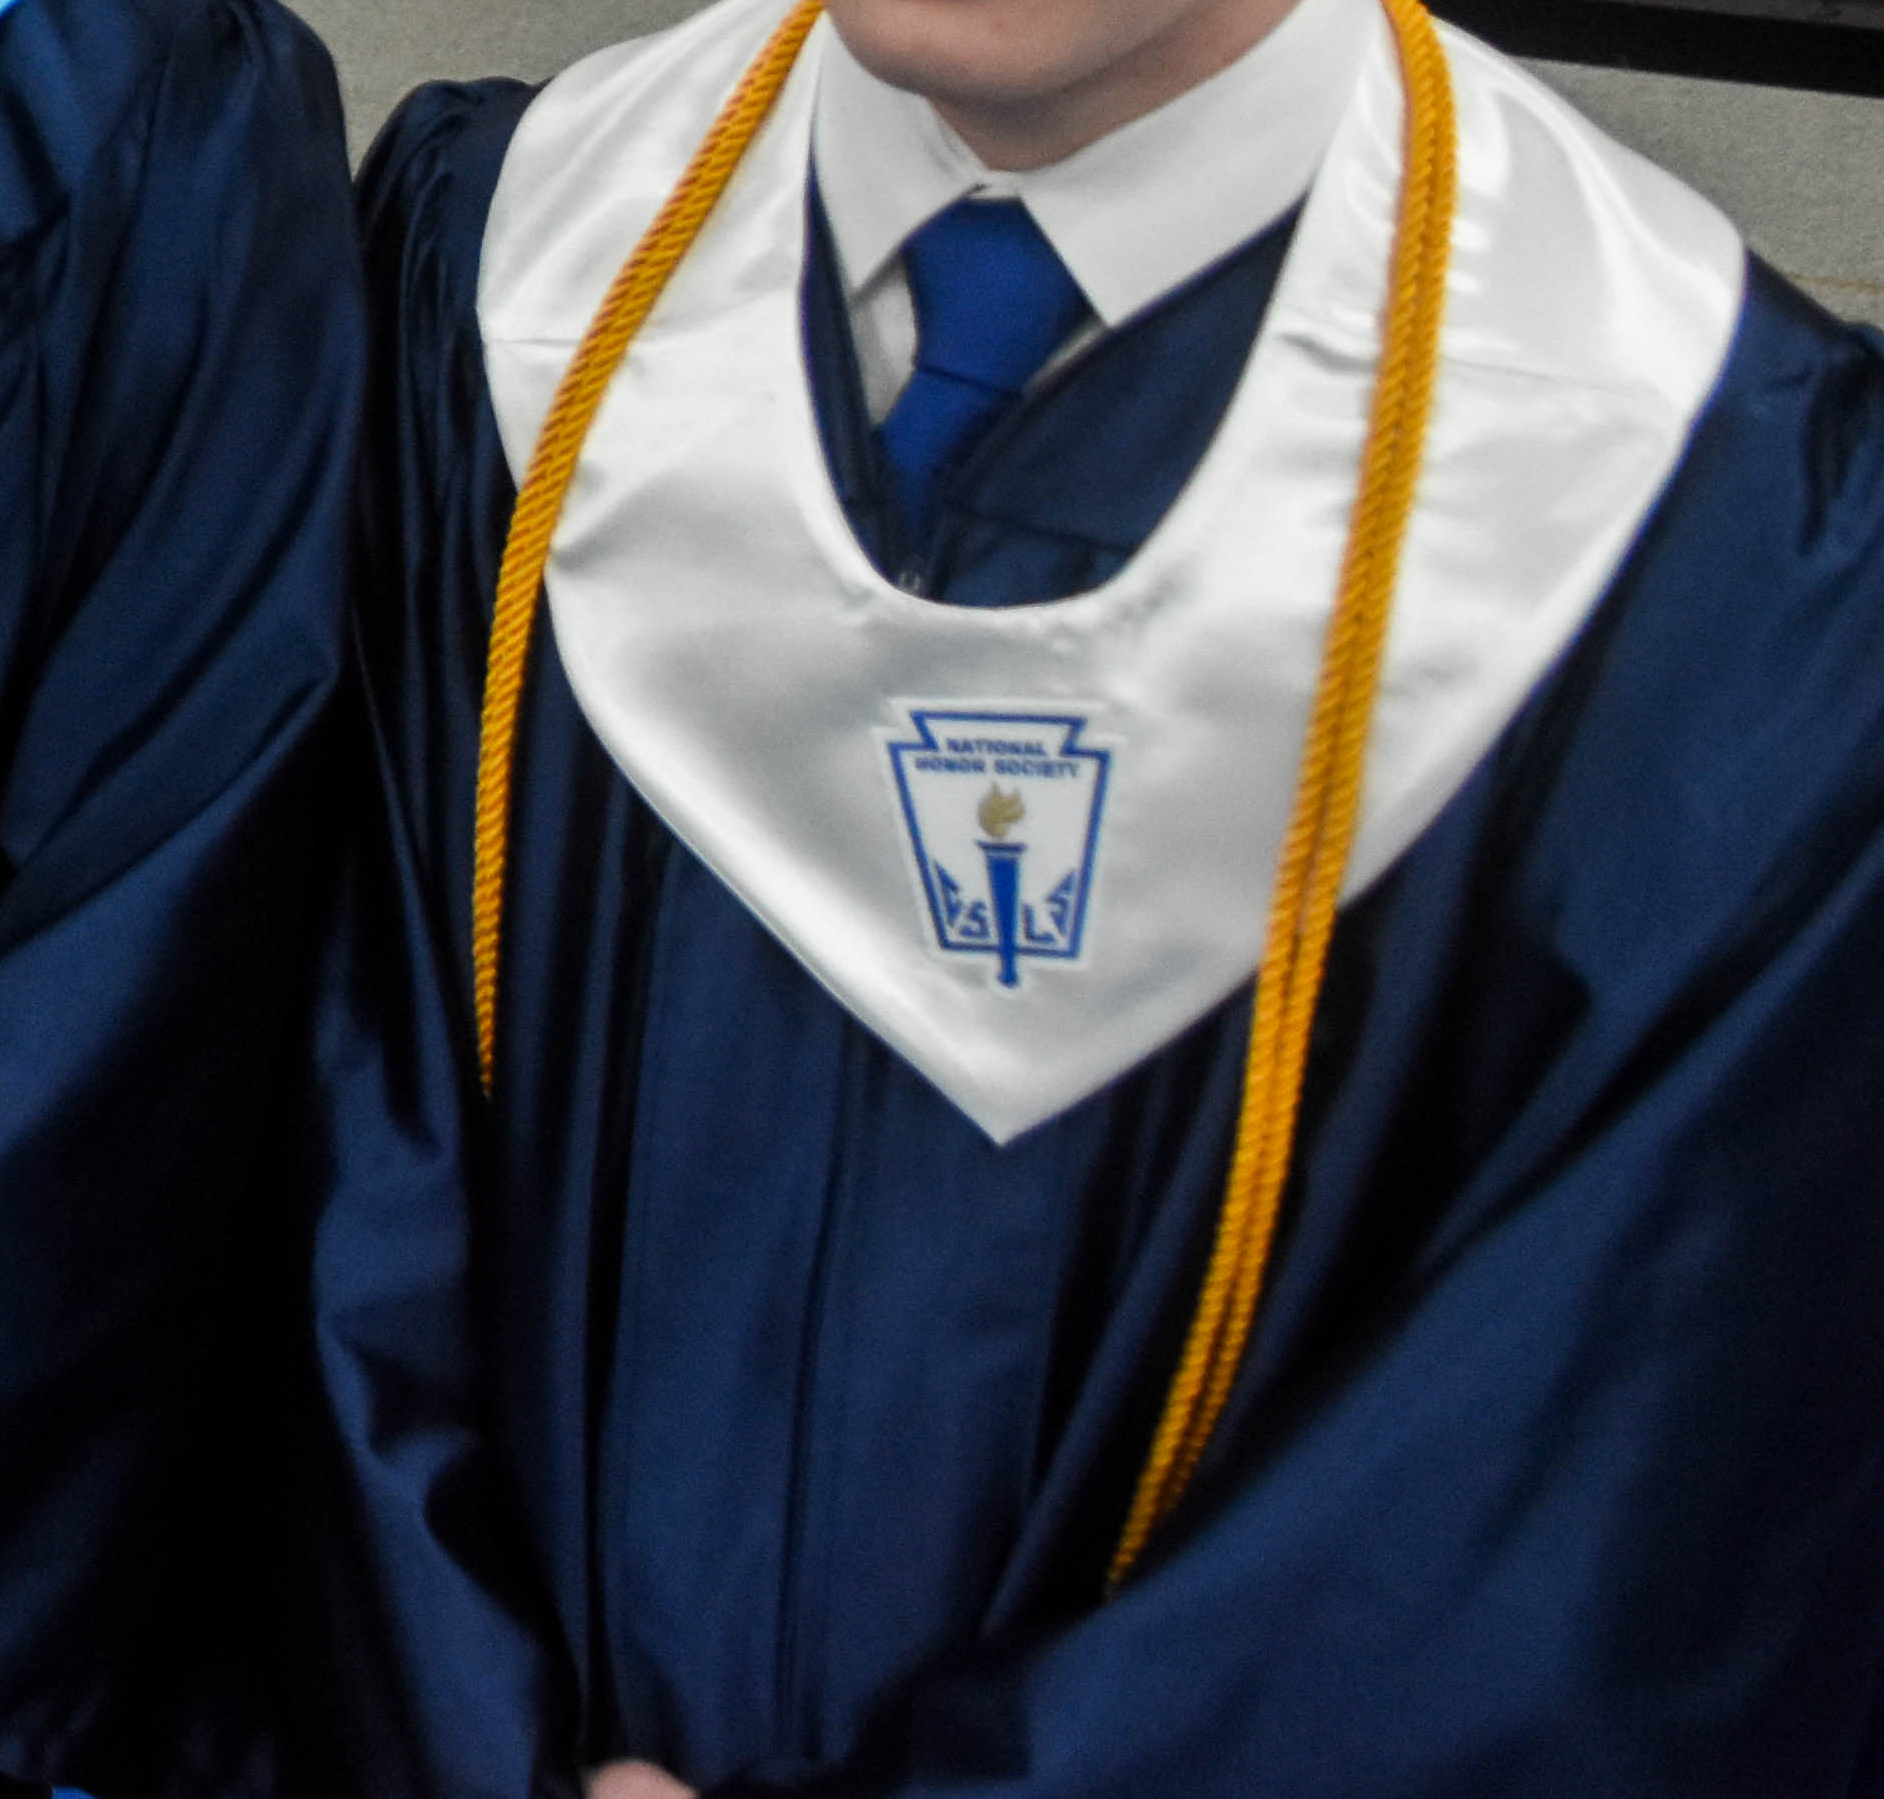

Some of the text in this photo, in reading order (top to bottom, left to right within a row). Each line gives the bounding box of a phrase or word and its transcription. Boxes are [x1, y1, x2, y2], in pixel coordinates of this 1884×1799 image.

[946, 738, 1049, 756] NATIONAL
[915, 757, 1080, 778] HONOR SOCIETY
